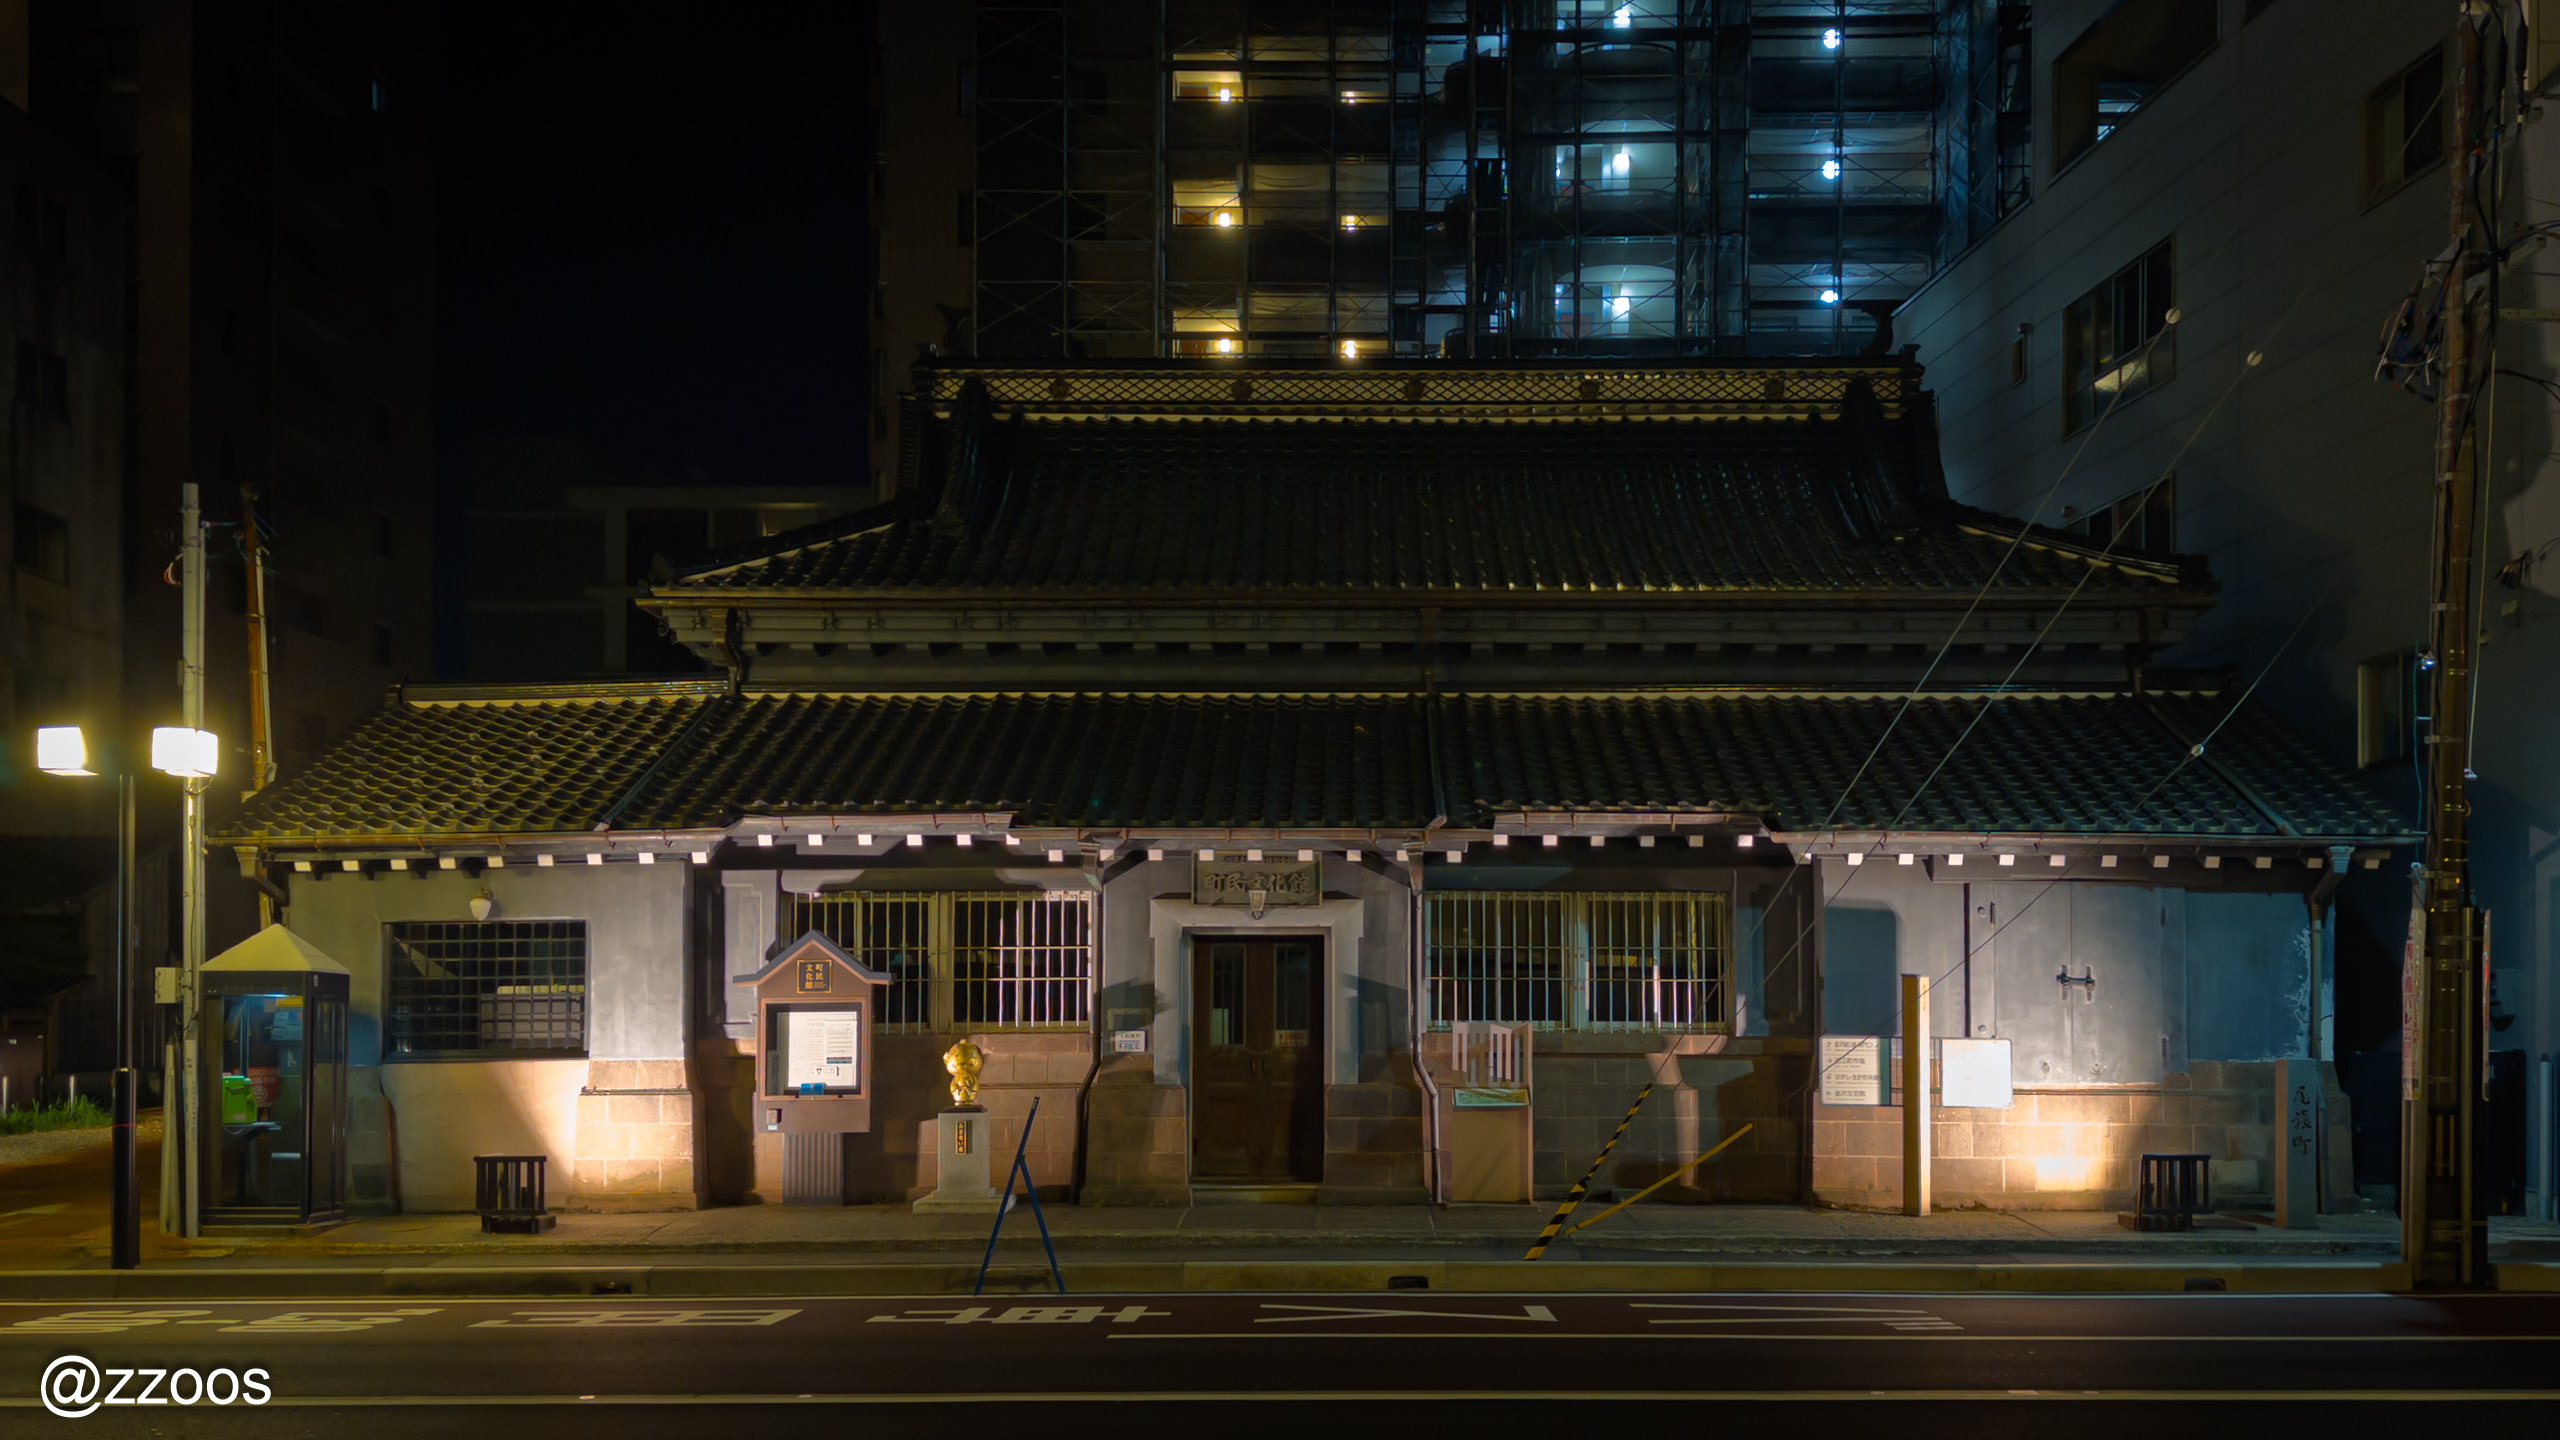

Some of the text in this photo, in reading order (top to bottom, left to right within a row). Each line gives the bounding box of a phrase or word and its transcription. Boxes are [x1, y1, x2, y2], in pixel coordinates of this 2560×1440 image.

[1204, 871, 1312, 894] 町民文化館
[1119, 1042, 1140, 1050] FREE
[2290, 1084, 2313, 1155] 尾張町
